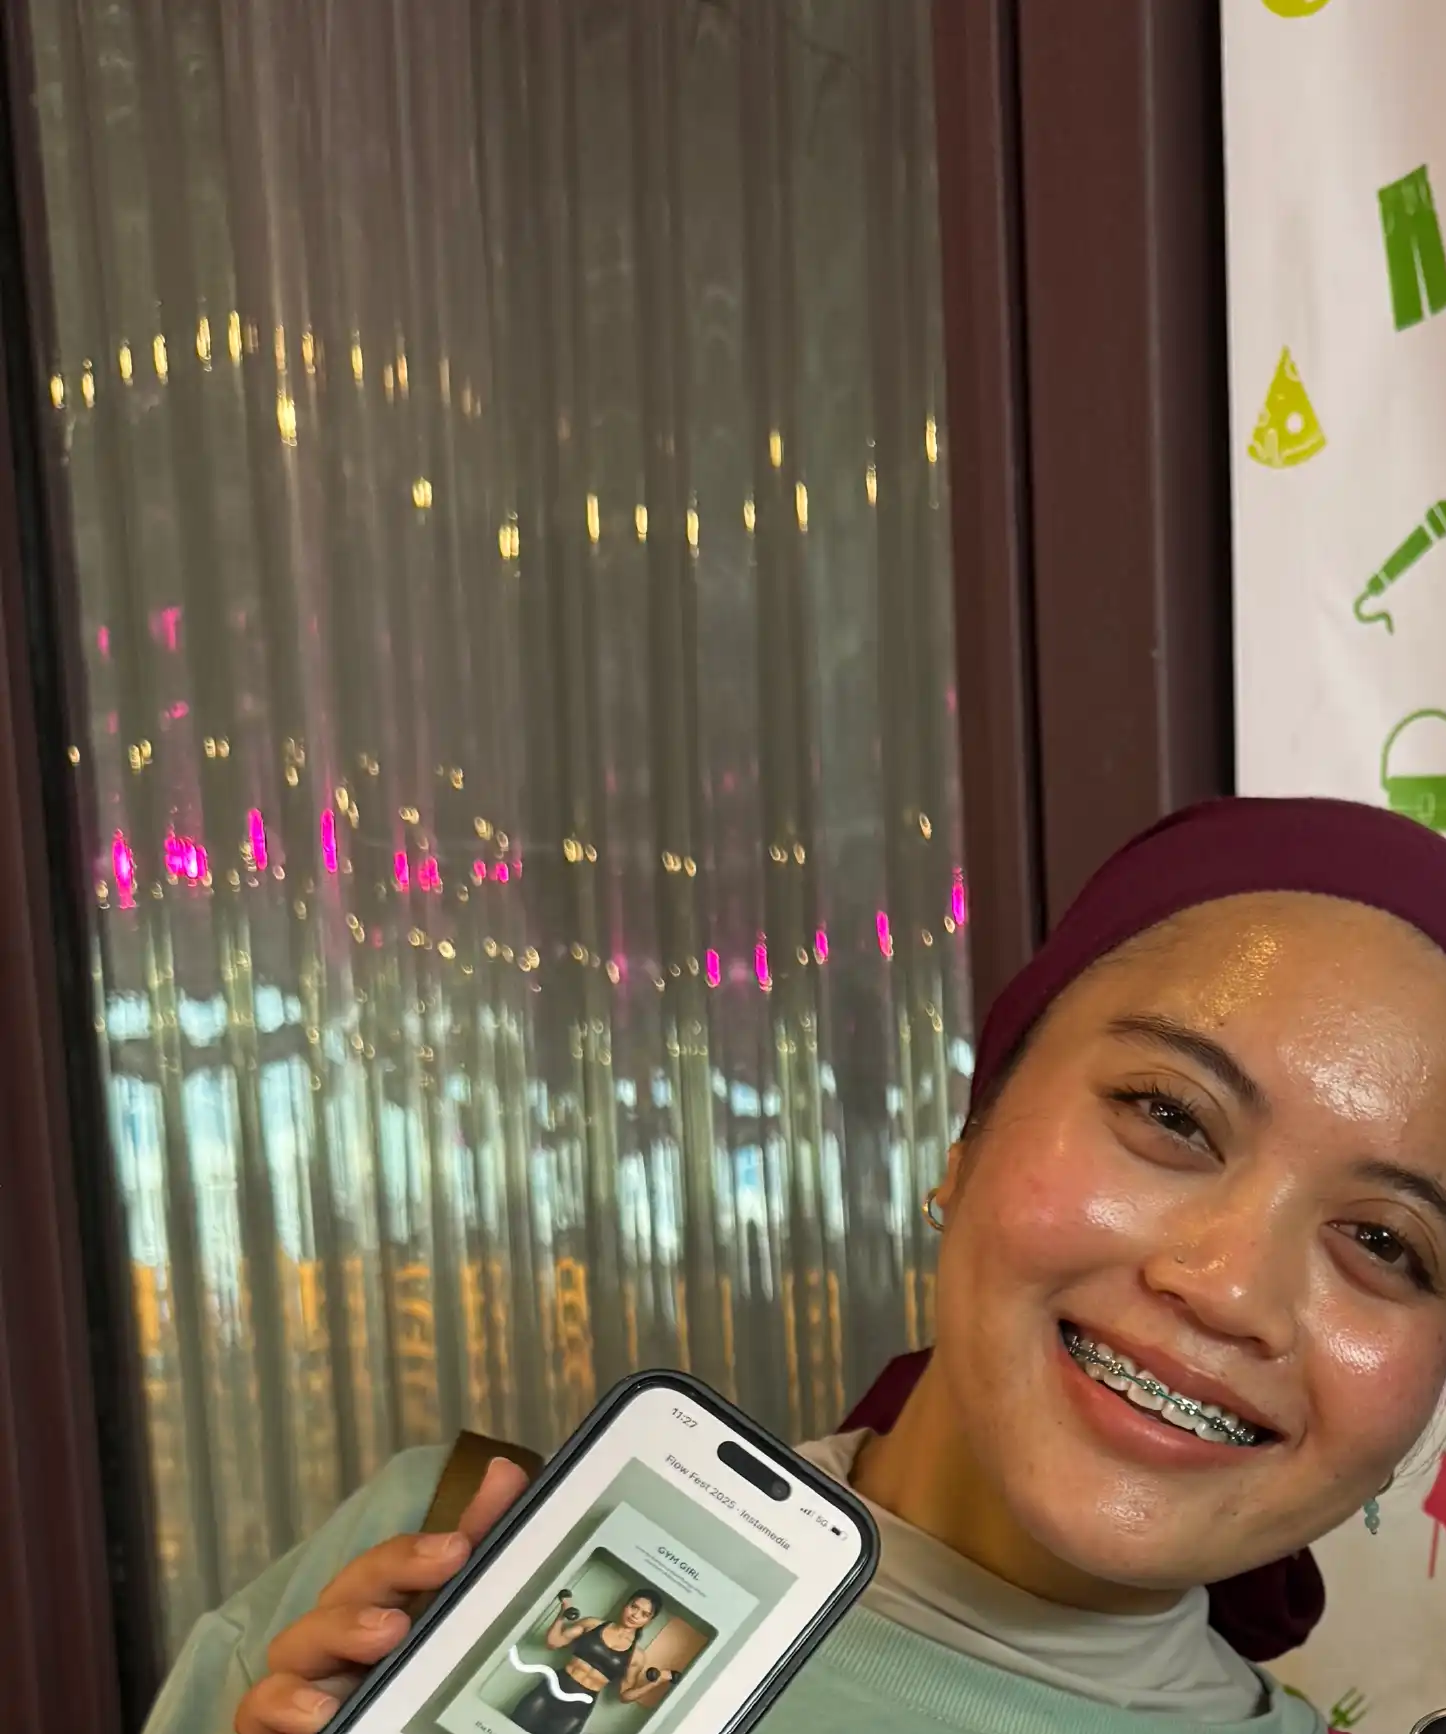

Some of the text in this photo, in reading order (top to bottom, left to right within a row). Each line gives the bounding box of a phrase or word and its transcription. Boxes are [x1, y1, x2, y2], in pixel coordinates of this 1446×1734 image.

[672, 1407, 698, 1428] 11:27
[666, 1454, 791, 1550] Flow Fest 2025 Instamedia
[657, 1546, 701, 1581] GYM GIRL
